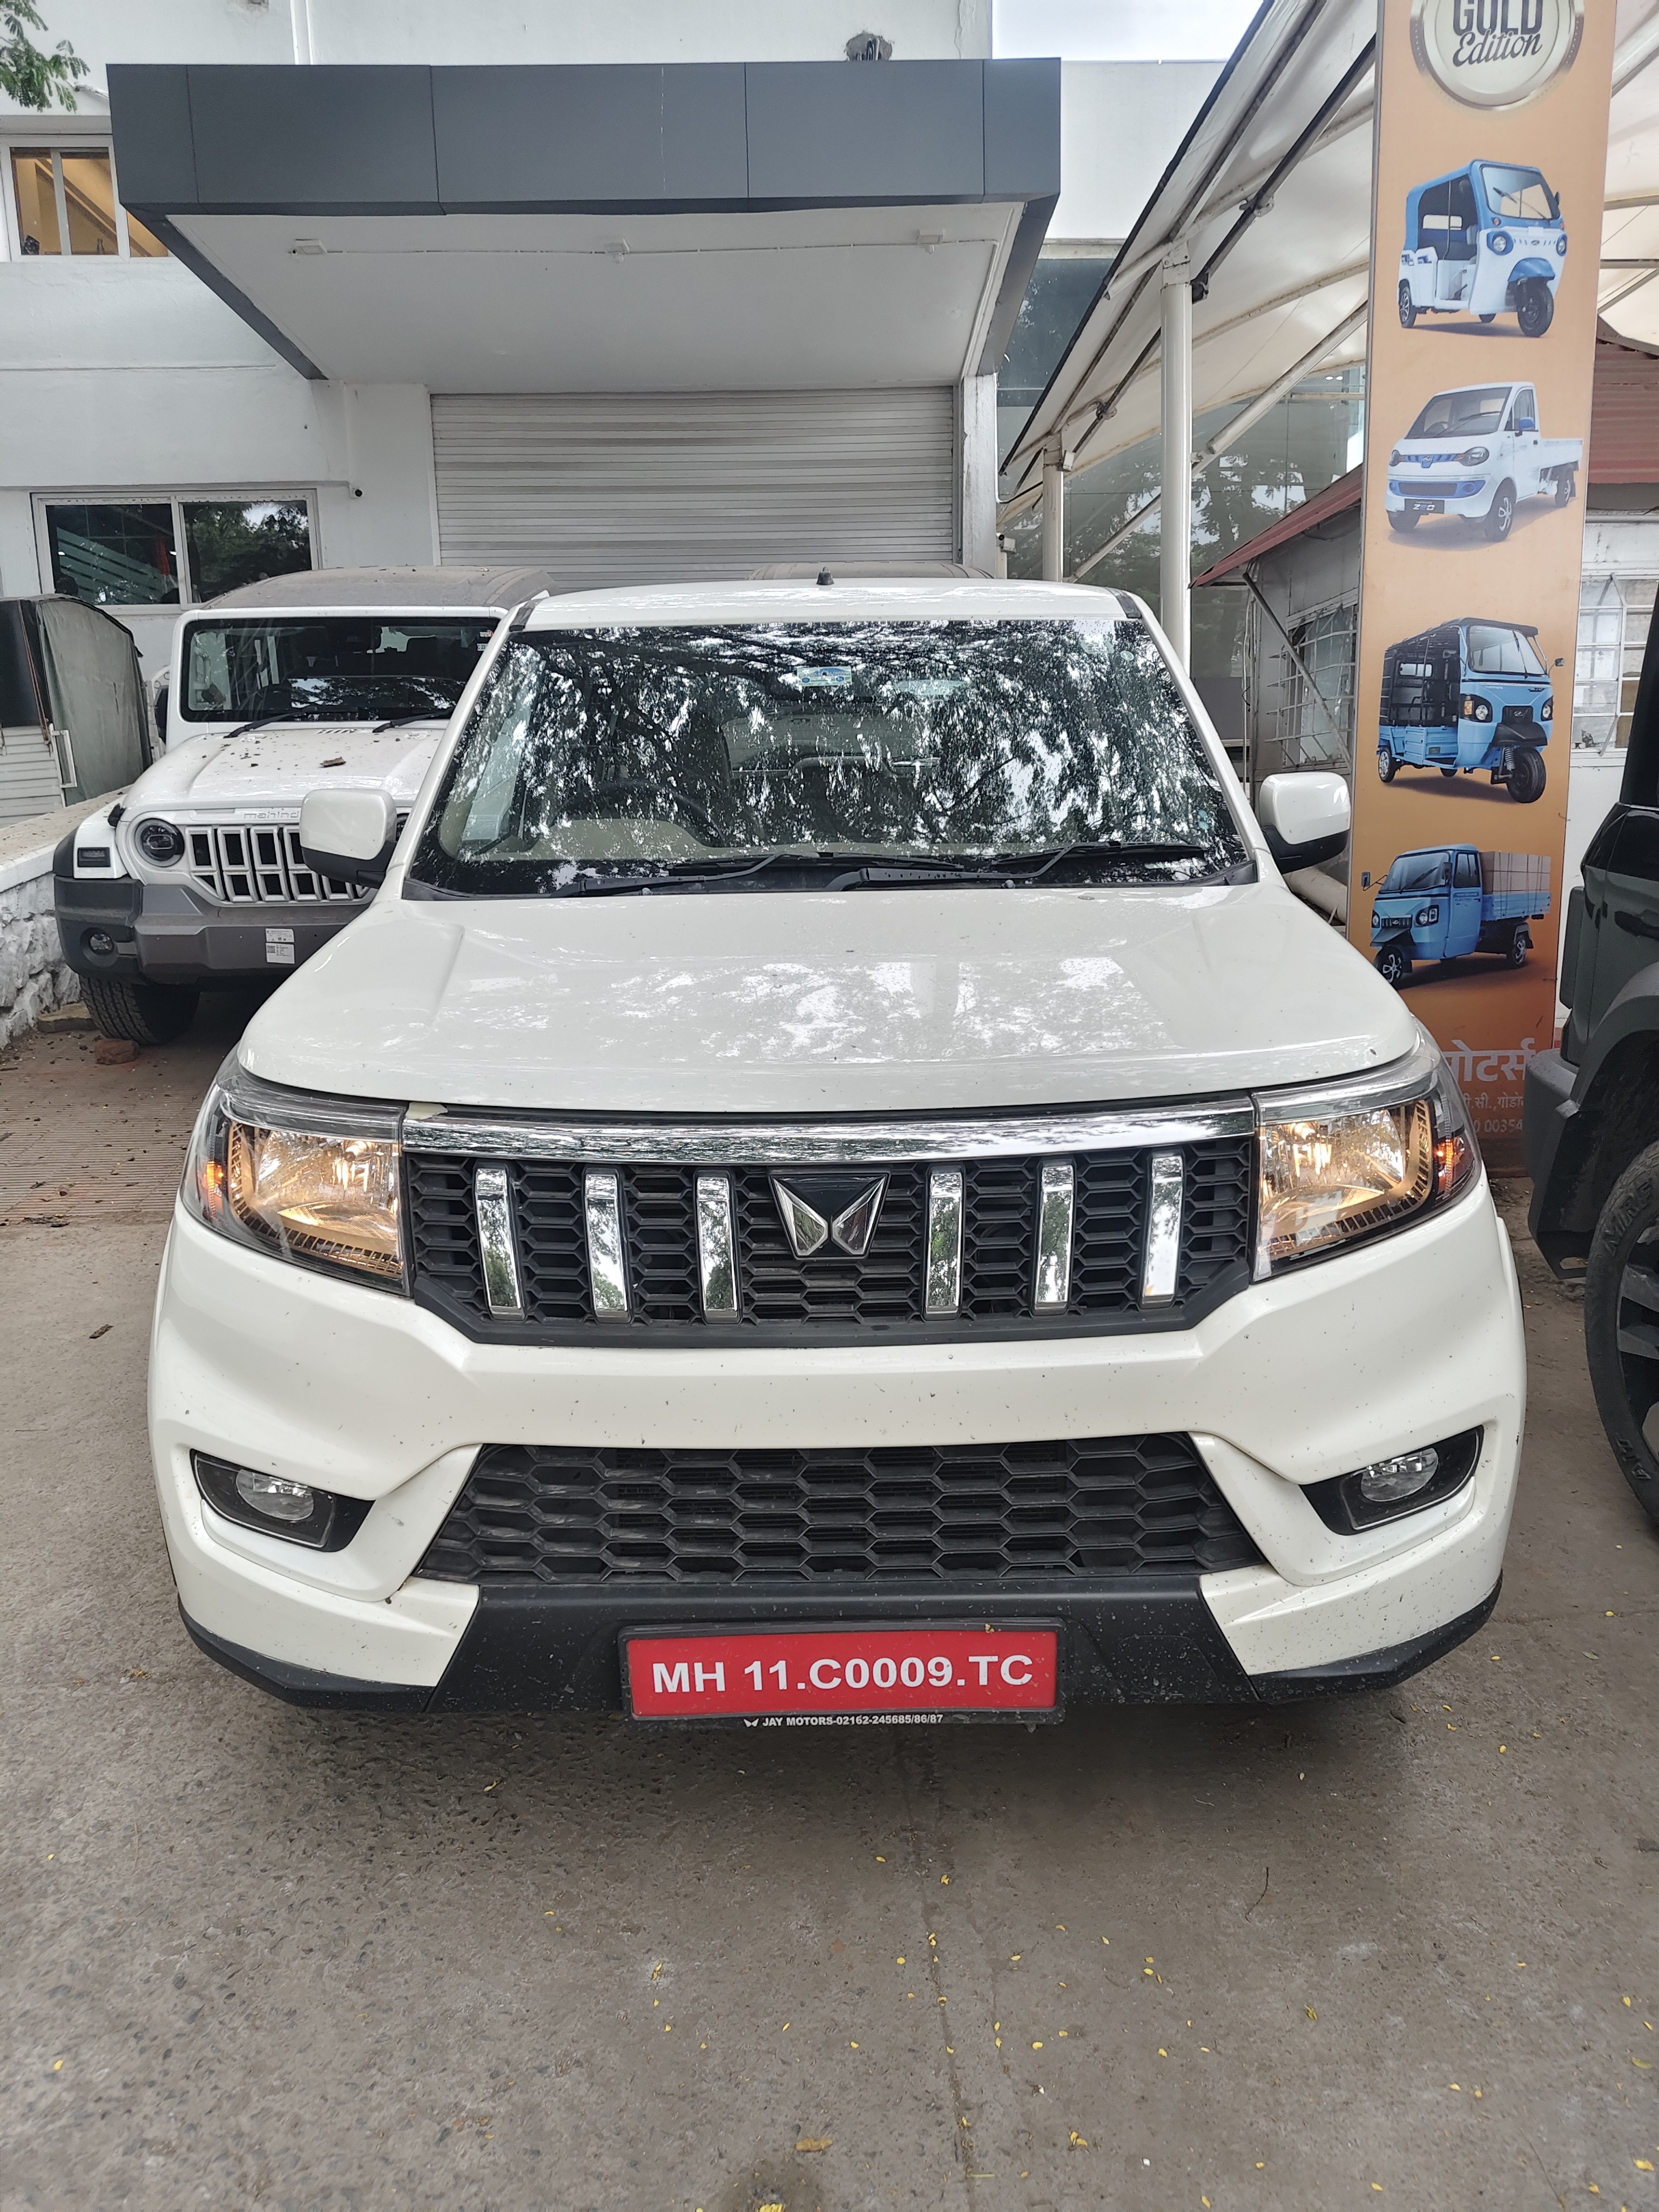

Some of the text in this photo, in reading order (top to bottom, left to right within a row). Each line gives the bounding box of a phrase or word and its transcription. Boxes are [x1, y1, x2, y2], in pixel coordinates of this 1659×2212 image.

[1453, 0, 1543, 36] GOLD
[1453, 29, 1543, 67] Edition
[653, 1655, 1033, 1692] MH 11.C0009.TC
[763, 1714, 943, 1727] JAY MOTORS-02162-245685/86/87
